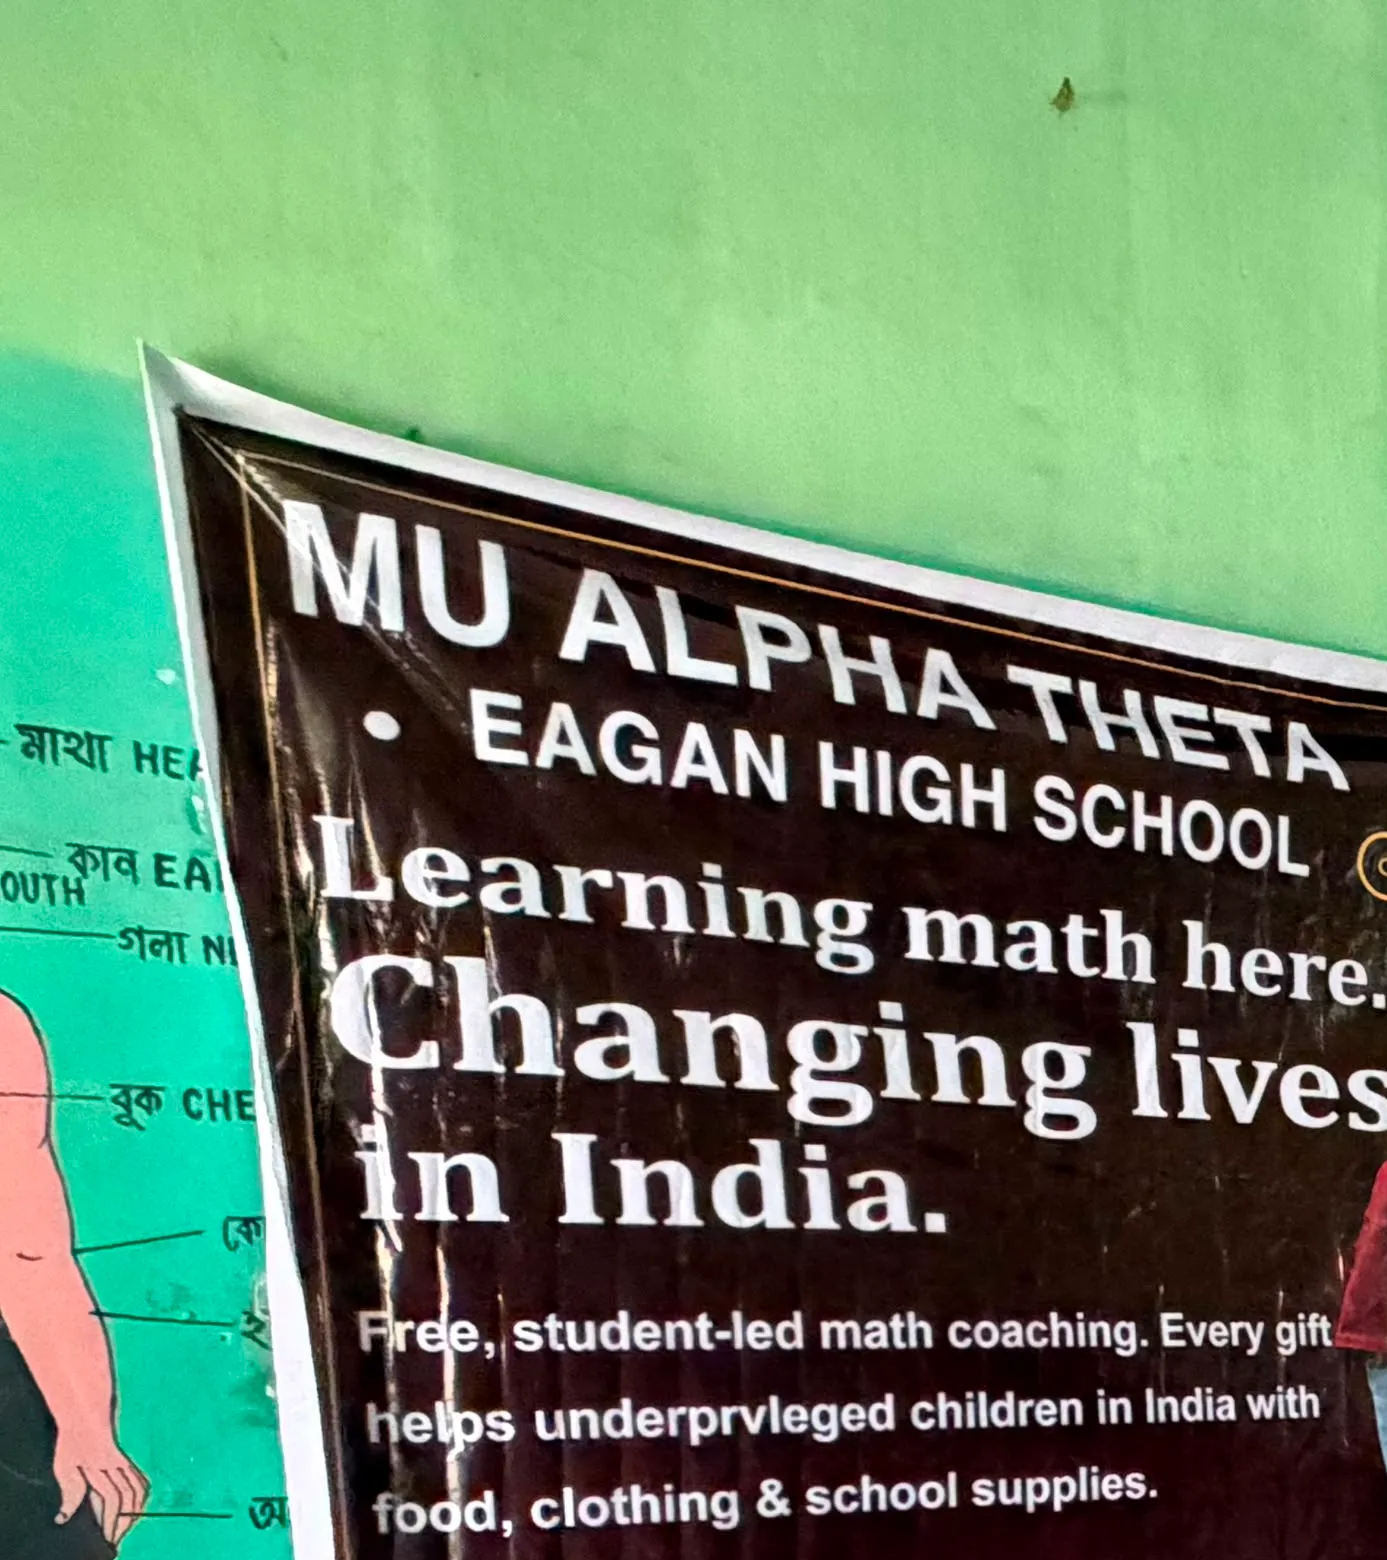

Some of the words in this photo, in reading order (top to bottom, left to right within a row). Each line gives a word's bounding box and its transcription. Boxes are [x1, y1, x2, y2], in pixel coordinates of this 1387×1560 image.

[283, 499, 511, 648] MU
[559, 567, 996, 730] ALPHA
[1008, 665, 1351, 792] THETA
[14, 723, 113, 773] মাথা
[469, 688, 787, 802] EAGAN
[818, 741, 1006, 833] HIGH
[1033, 775, 1310, 878] SCHOOL
[65, 842, 140, 885] কান
[117, 926, 190, 961] গলা
[311, 814, 874, 975] Learning
[903, 904, 1155, 984] math
[1181, 919, 1387, 1009] here.
[330, 954, 1098, 1140] Changing
[109, 1083, 165, 1131] বুক
[353, 1126, 509, 1225] in
[551, 1130, 947, 1234] India.
[360, 1314, 497, 1360] Free,
[513, 1310, 804, 1353] student-led
[820, 1310, 932, 1352] math
[947, 1312, 1149, 1358] coaching.
[1160, 1311, 1267, 1357] Every
[1276, 1310, 1333, 1357] gift
[367, 1403, 516, 1447] helps
[535, 1394, 894, 1445] underprvleged
[909, 1388, 1084, 1430] children
[1096, 1389, 1133, 1425] in
[1144, 1387, 1237, 1425] India
[1246, 1383, 1321, 1421] with
[372, 1492, 514, 1539] food,
[530, 1487, 740, 1532] clothing
[756, 1479, 792, 1519] &
[806, 1471, 957, 1514] school
[971, 1467, 1159, 1513] supplies.
